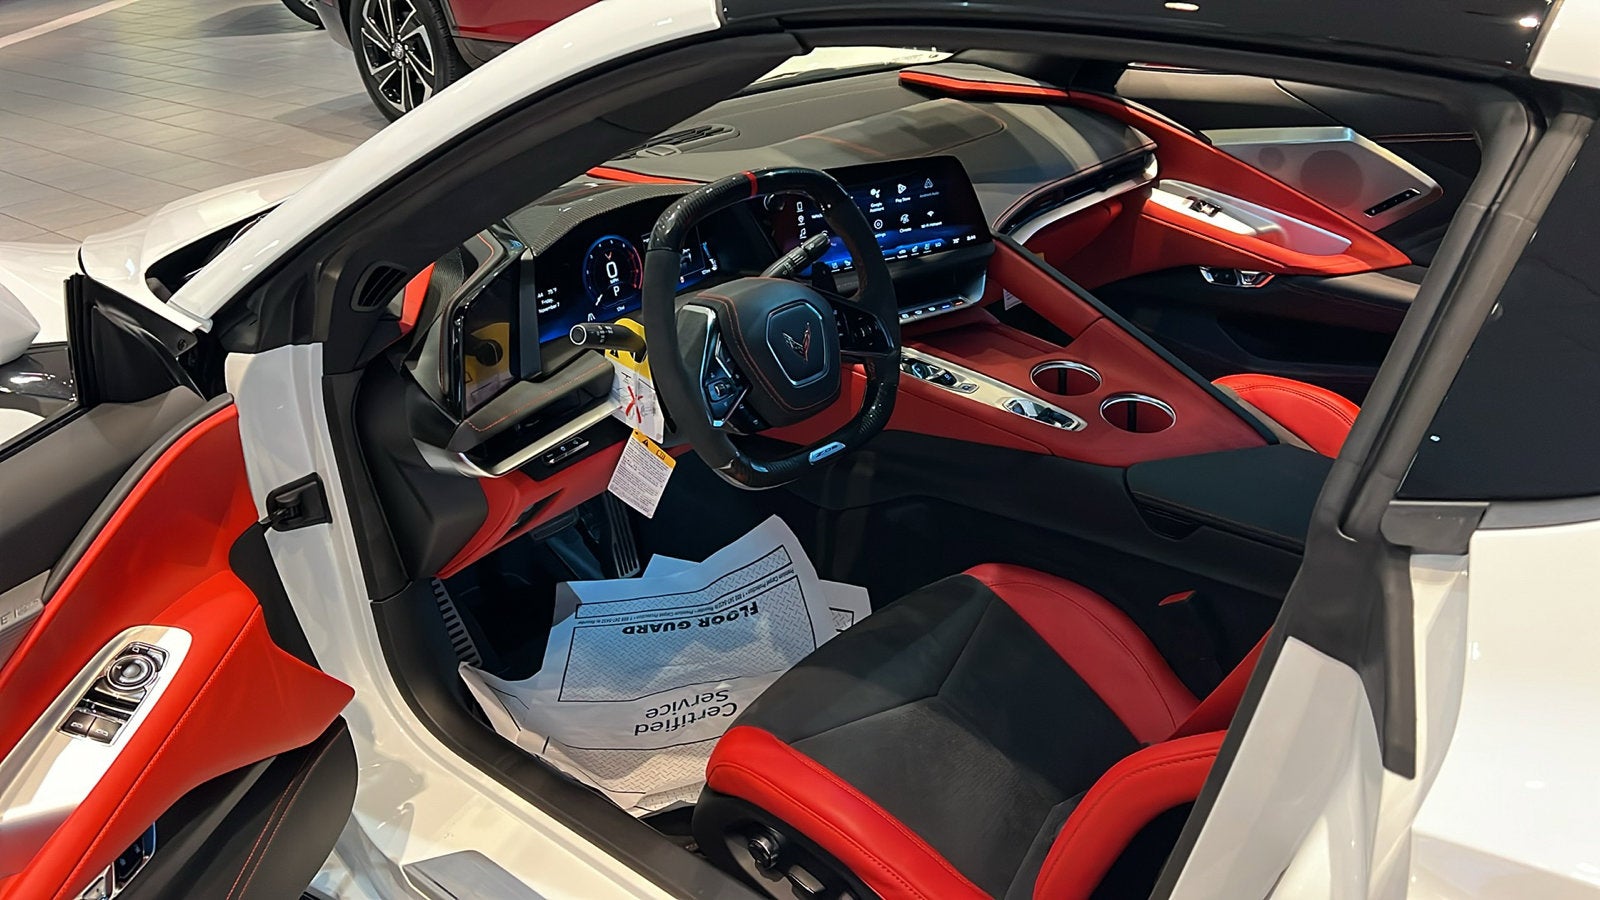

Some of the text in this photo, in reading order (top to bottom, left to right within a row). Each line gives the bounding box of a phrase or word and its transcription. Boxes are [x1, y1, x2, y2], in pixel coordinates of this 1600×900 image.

[606, 261, 618, 278] 0
[613, 285, 620, 296] P
[747, 584, 766, 593] Protection
[766, 575, 778, 586] Carpet
[621, 601, 759, 635] FLOOR GUARD
[645, 689, 729, 719] Service
[634, 702, 738, 736] Certified
